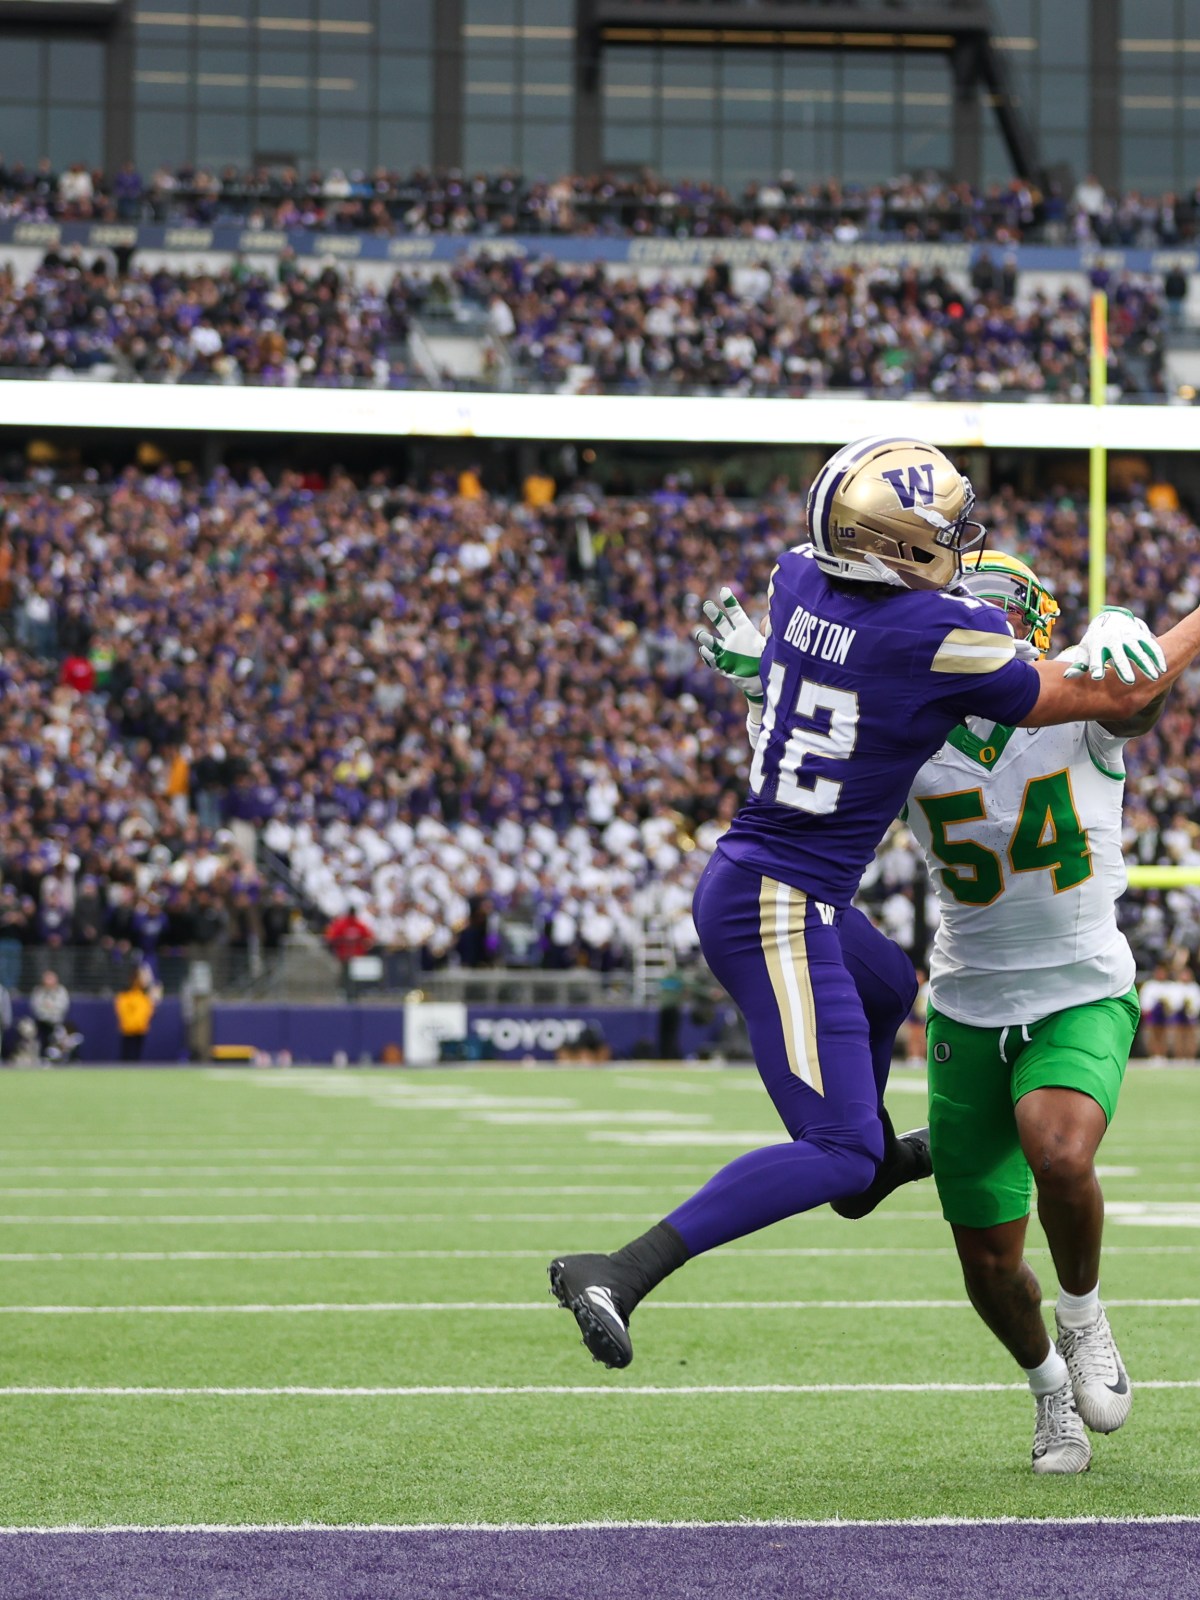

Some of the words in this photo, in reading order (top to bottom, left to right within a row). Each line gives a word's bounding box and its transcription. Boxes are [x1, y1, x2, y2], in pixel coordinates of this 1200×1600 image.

[881, 463, 935, 509] W
[784, 605, 856, 665] BOSTON
[749, 659, 860, 815] 12
[979, 746, 996, 763] O
[915, 767, 1094, 907] 54
[815, 901, 835, 925] W
[472, 1018, 602, 1051] TOYOT
[934, 1043, 950, 1062] O
